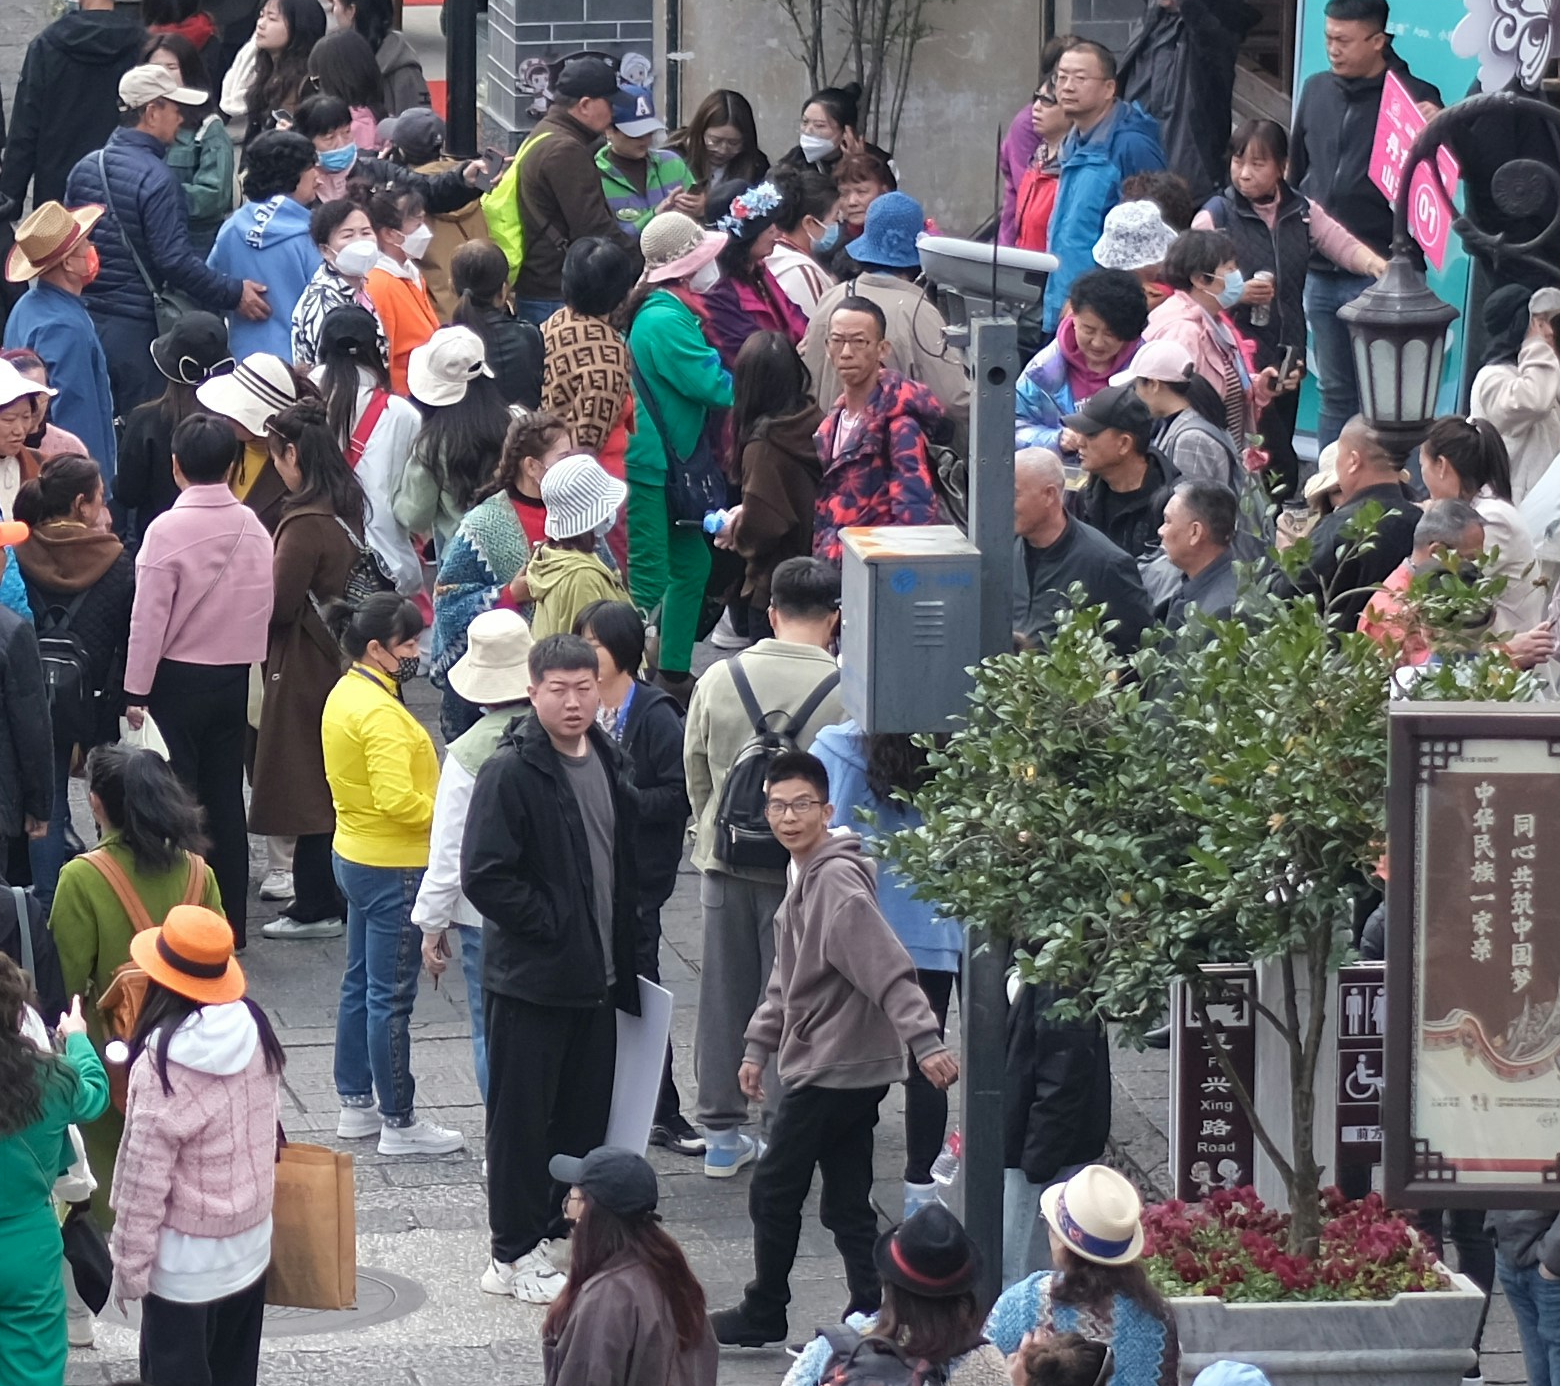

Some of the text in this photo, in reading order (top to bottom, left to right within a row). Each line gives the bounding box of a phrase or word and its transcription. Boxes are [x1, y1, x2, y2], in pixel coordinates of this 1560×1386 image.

[1418, 193, 1436, 234] 01
[1469, 781, 1496, 963] 中华民族一家亲
[1509, 813, 1536, 994] 同心共筑中国梦
[1200, 1077, 1232, 1093] 兴
[1200, 1100, 1233, 1113] Xing
[1200, 1118, 1232, 1136] 路
[1197, 1141, 1236, 1153] Road
